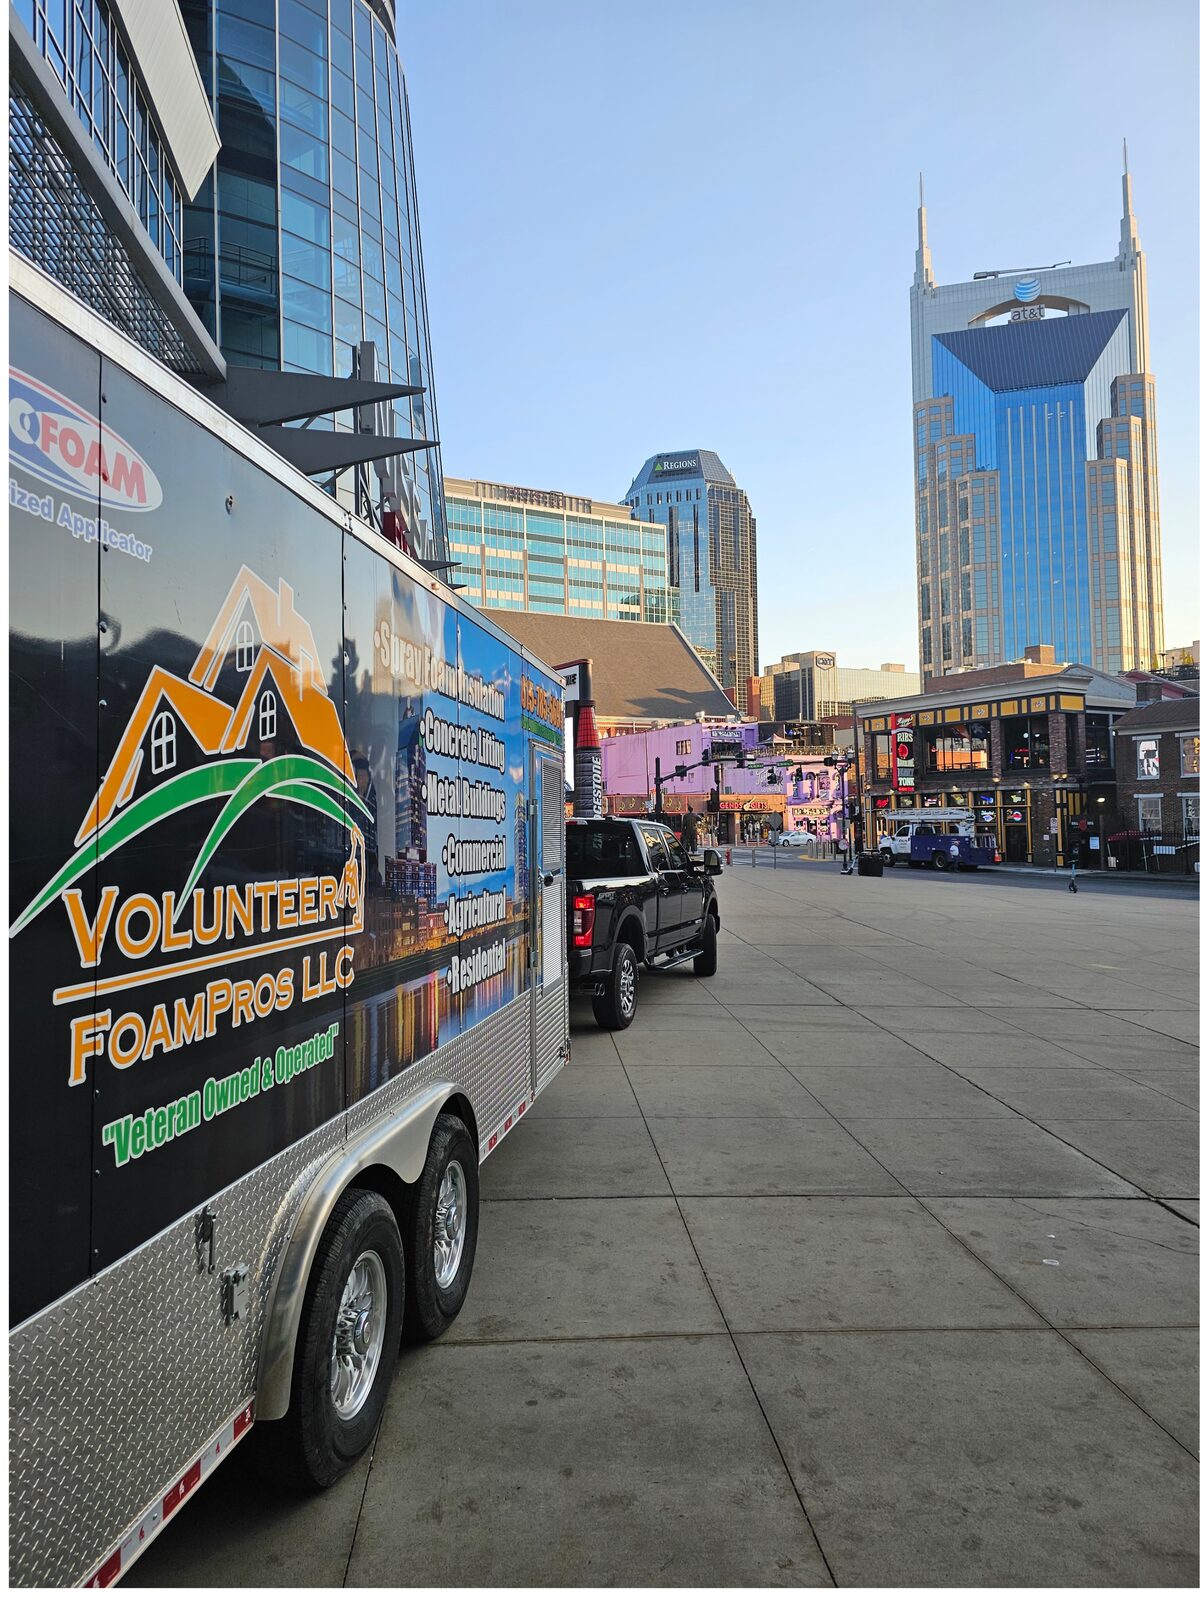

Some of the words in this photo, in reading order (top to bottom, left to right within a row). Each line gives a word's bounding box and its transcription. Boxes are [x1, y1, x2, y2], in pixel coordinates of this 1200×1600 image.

[1012, 304, 1045, 321] at&t
[663, 459, 697, 470] REGIONS
[9, 480, 54, 522] ized
[57, 501, 152, 562] Applicator
[380, 620, 422, 687] Spray
[423, 645, 457, 701] Foam
[457, 664, 505, 722] Insulation
[424, 707, 477, 764] Concrete
[477, 727, 505, 775] Lifting
[896, 732, 914, 742] RIBS
[426, 769, 461, 817] Metal
[461, 777, 506, 824] Buildings
[446, 833, 506, 876] Commercial
[62, 876, 341, 968] VOLUNTEER
[448, 885, 506, 937] Agricultural
[302, 945, 355, 1003] LLC
[451, 938, 506, 995] Residential
[102, 1089, 201, 1168] "Veteran
[203, 1056, 261, 1122] Owned
[262, 1065, 275, 1093] &
[274, 1022, 340, 1085] Operated"
